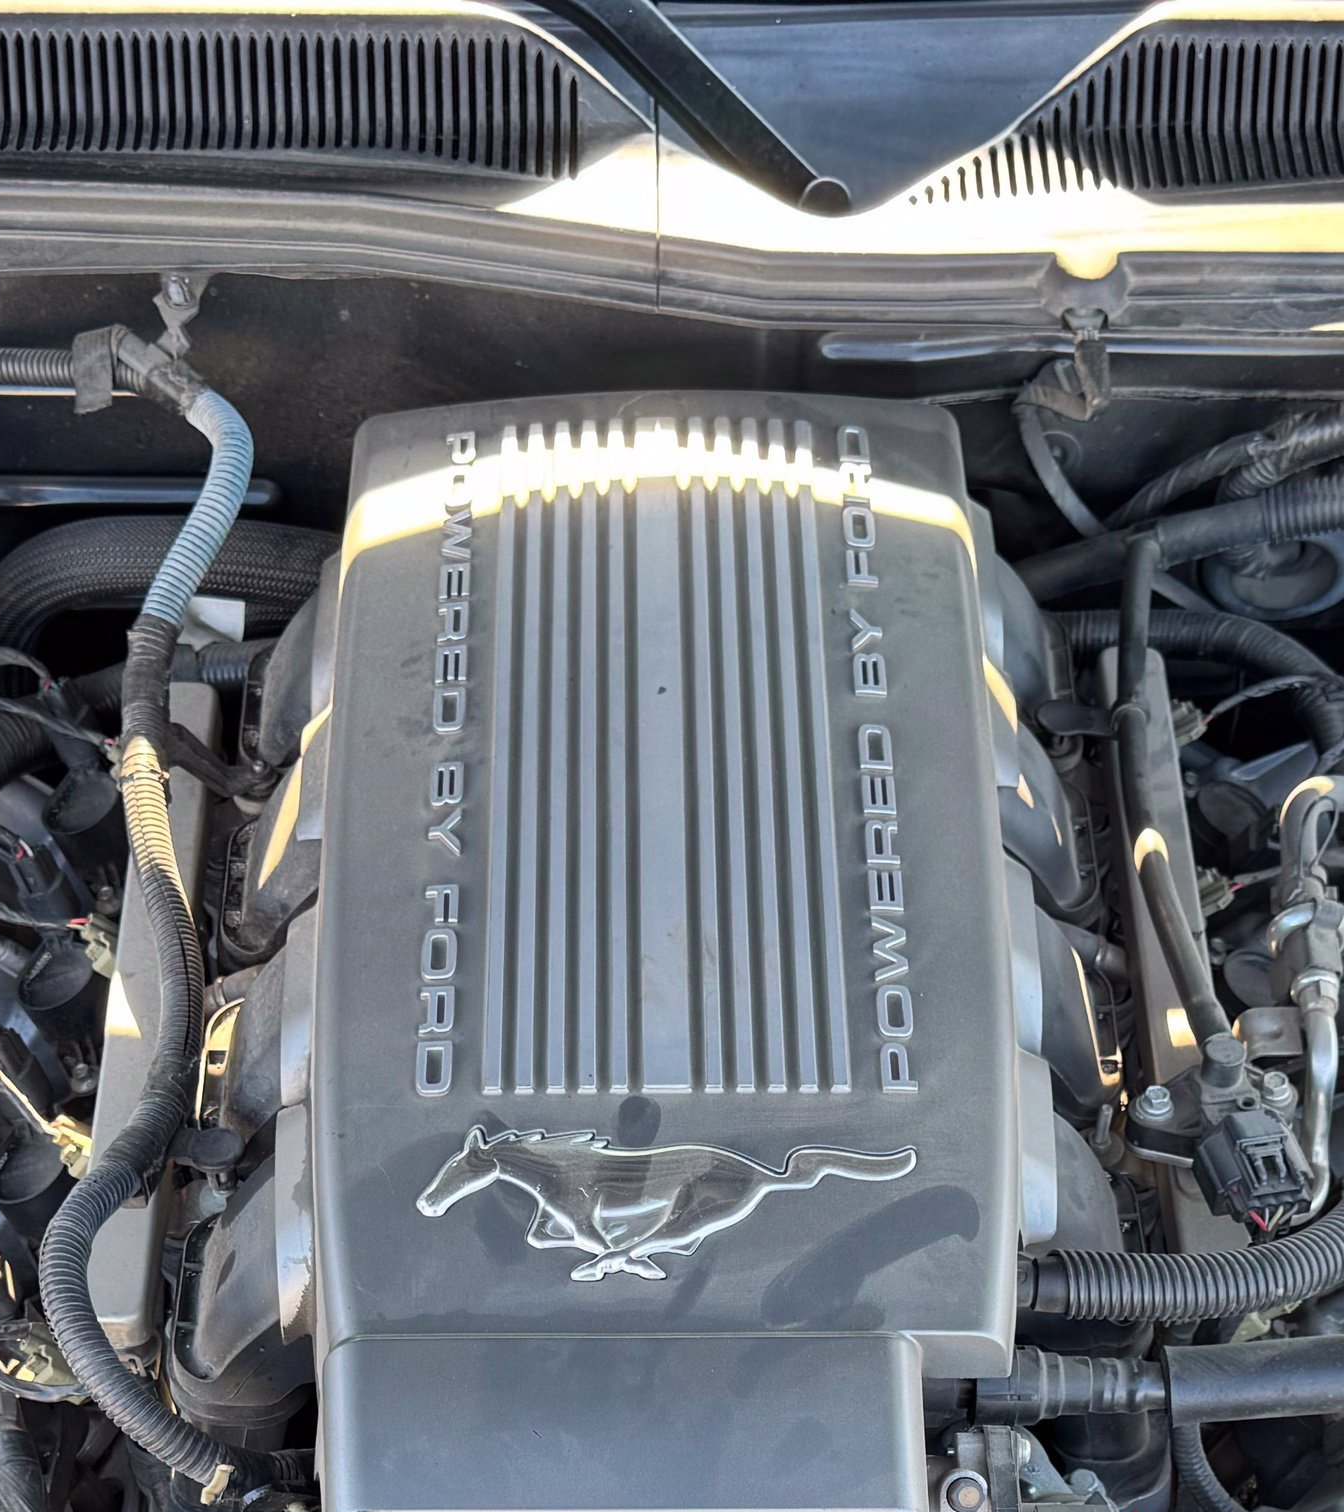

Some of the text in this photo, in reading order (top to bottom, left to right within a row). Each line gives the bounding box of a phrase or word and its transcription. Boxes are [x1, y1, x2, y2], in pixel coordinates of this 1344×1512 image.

[415, 430, 480, 1098] POWERED BY FORD
[837, 423, 920, 1094] POWERED BY FORD
